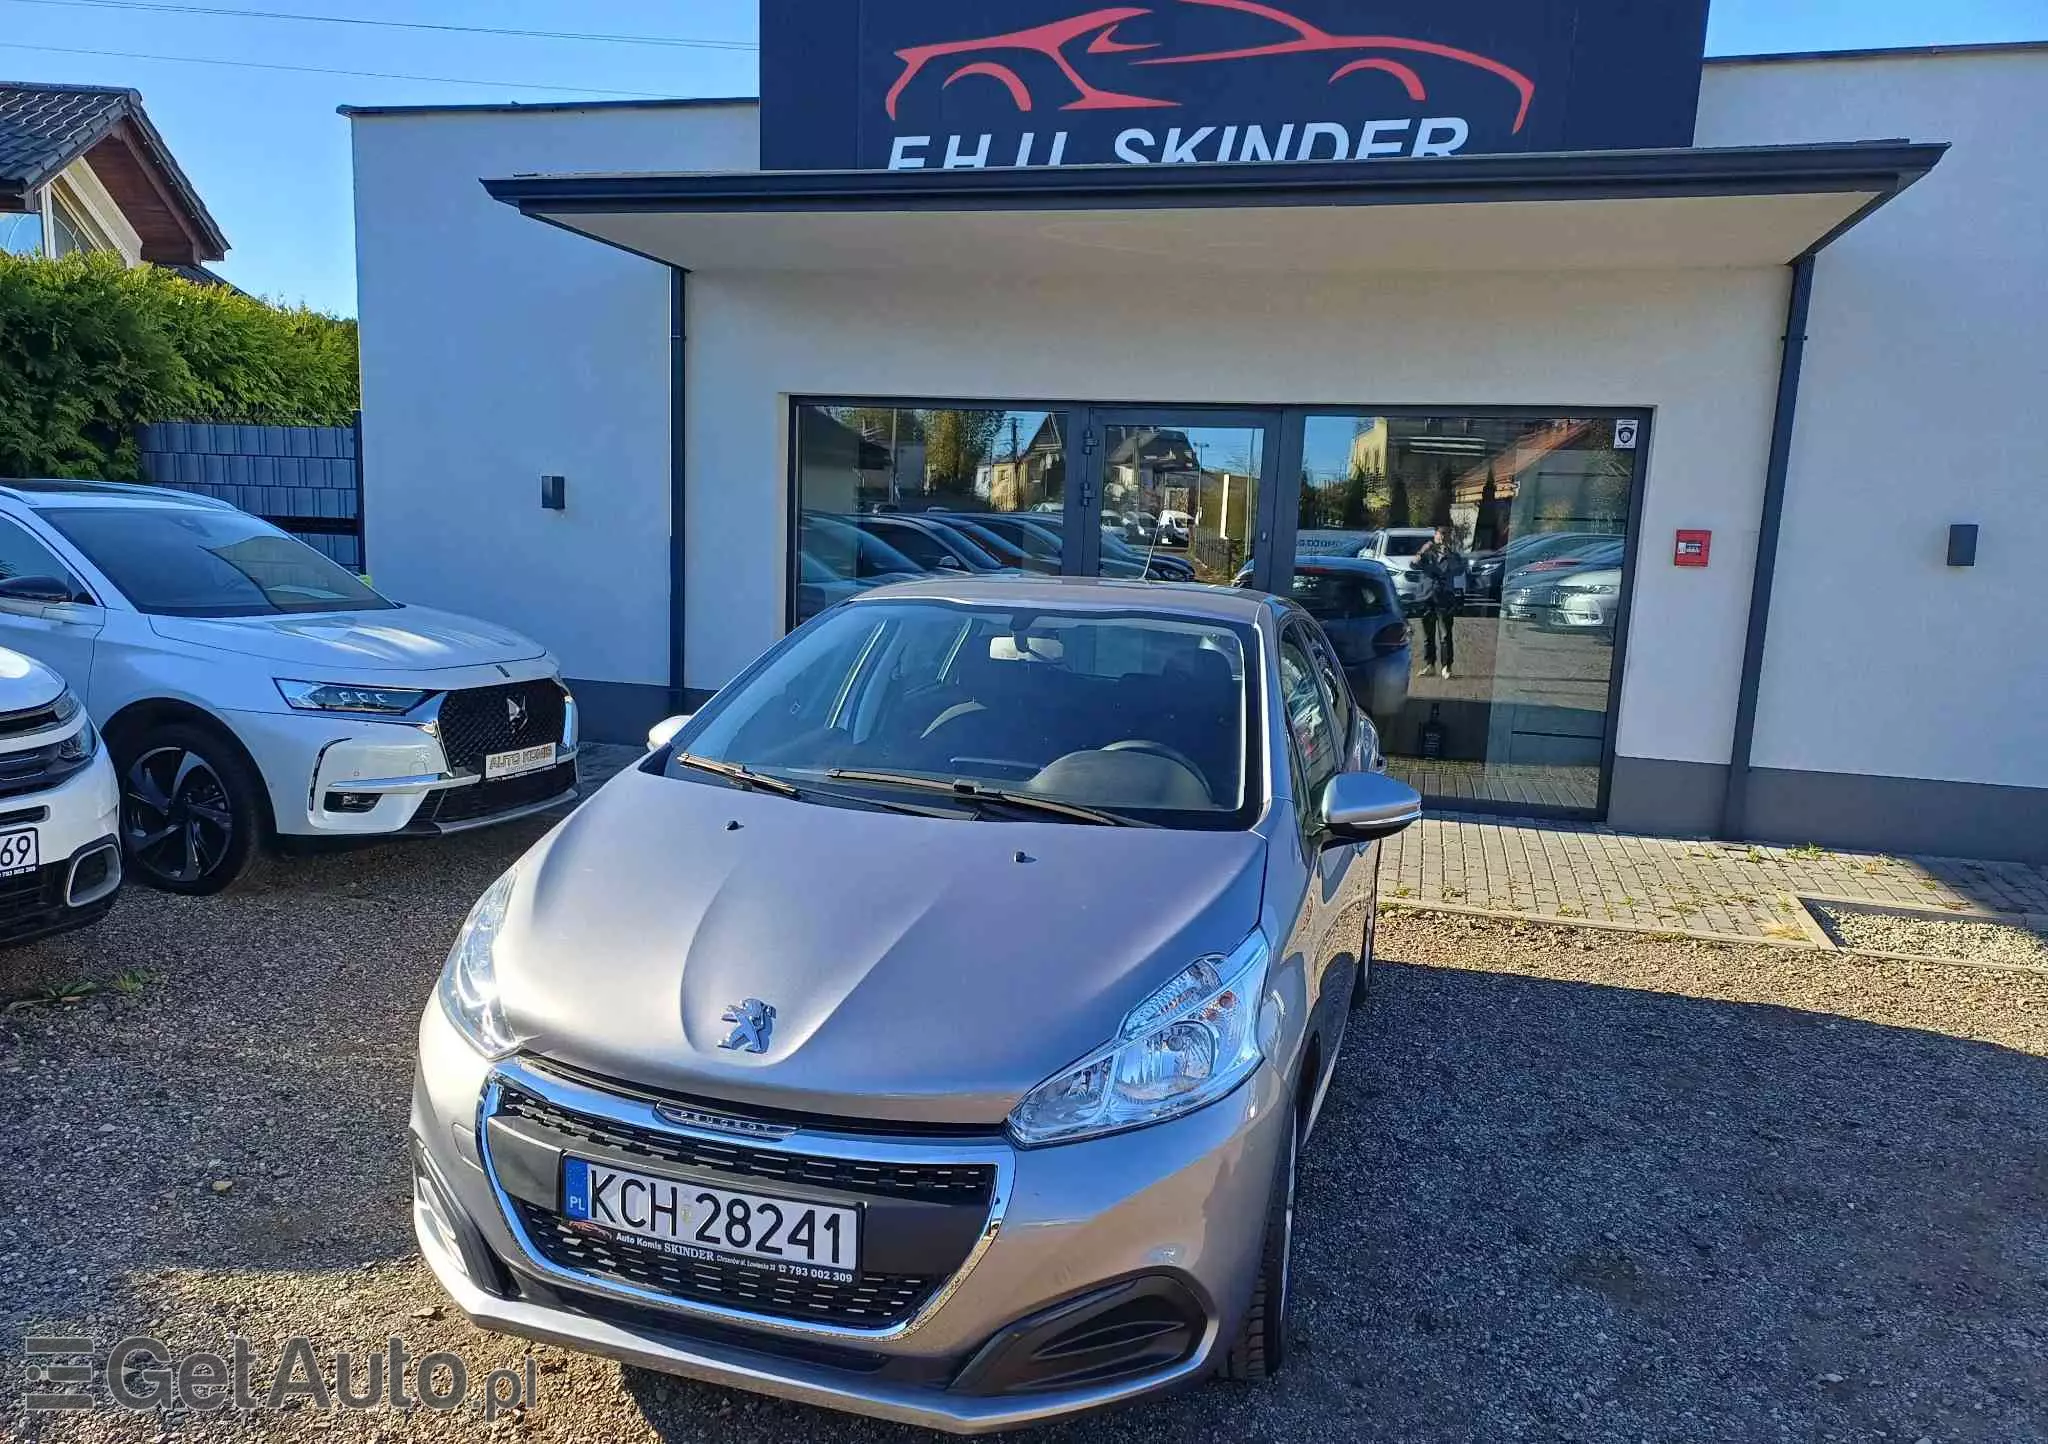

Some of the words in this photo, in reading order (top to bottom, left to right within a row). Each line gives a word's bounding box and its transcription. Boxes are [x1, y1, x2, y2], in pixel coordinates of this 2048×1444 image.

[1114, 117, 1469, 164] SKINDER
[569, 1196, 586, 1212] PL
[590, 1170, 679, 1237] KCH
[695, 1192, 840, 1264] 28241
[616, 1232, 635, 1245] Auto
[636, 1237, 662, 1251] Komis
[664, 1242, 714, 1262] SKINDER
[789, 1265, 808, 1277] 793
[811, 1269, 831, 1280] 002
[833, 1272, 853, 1283] 309
